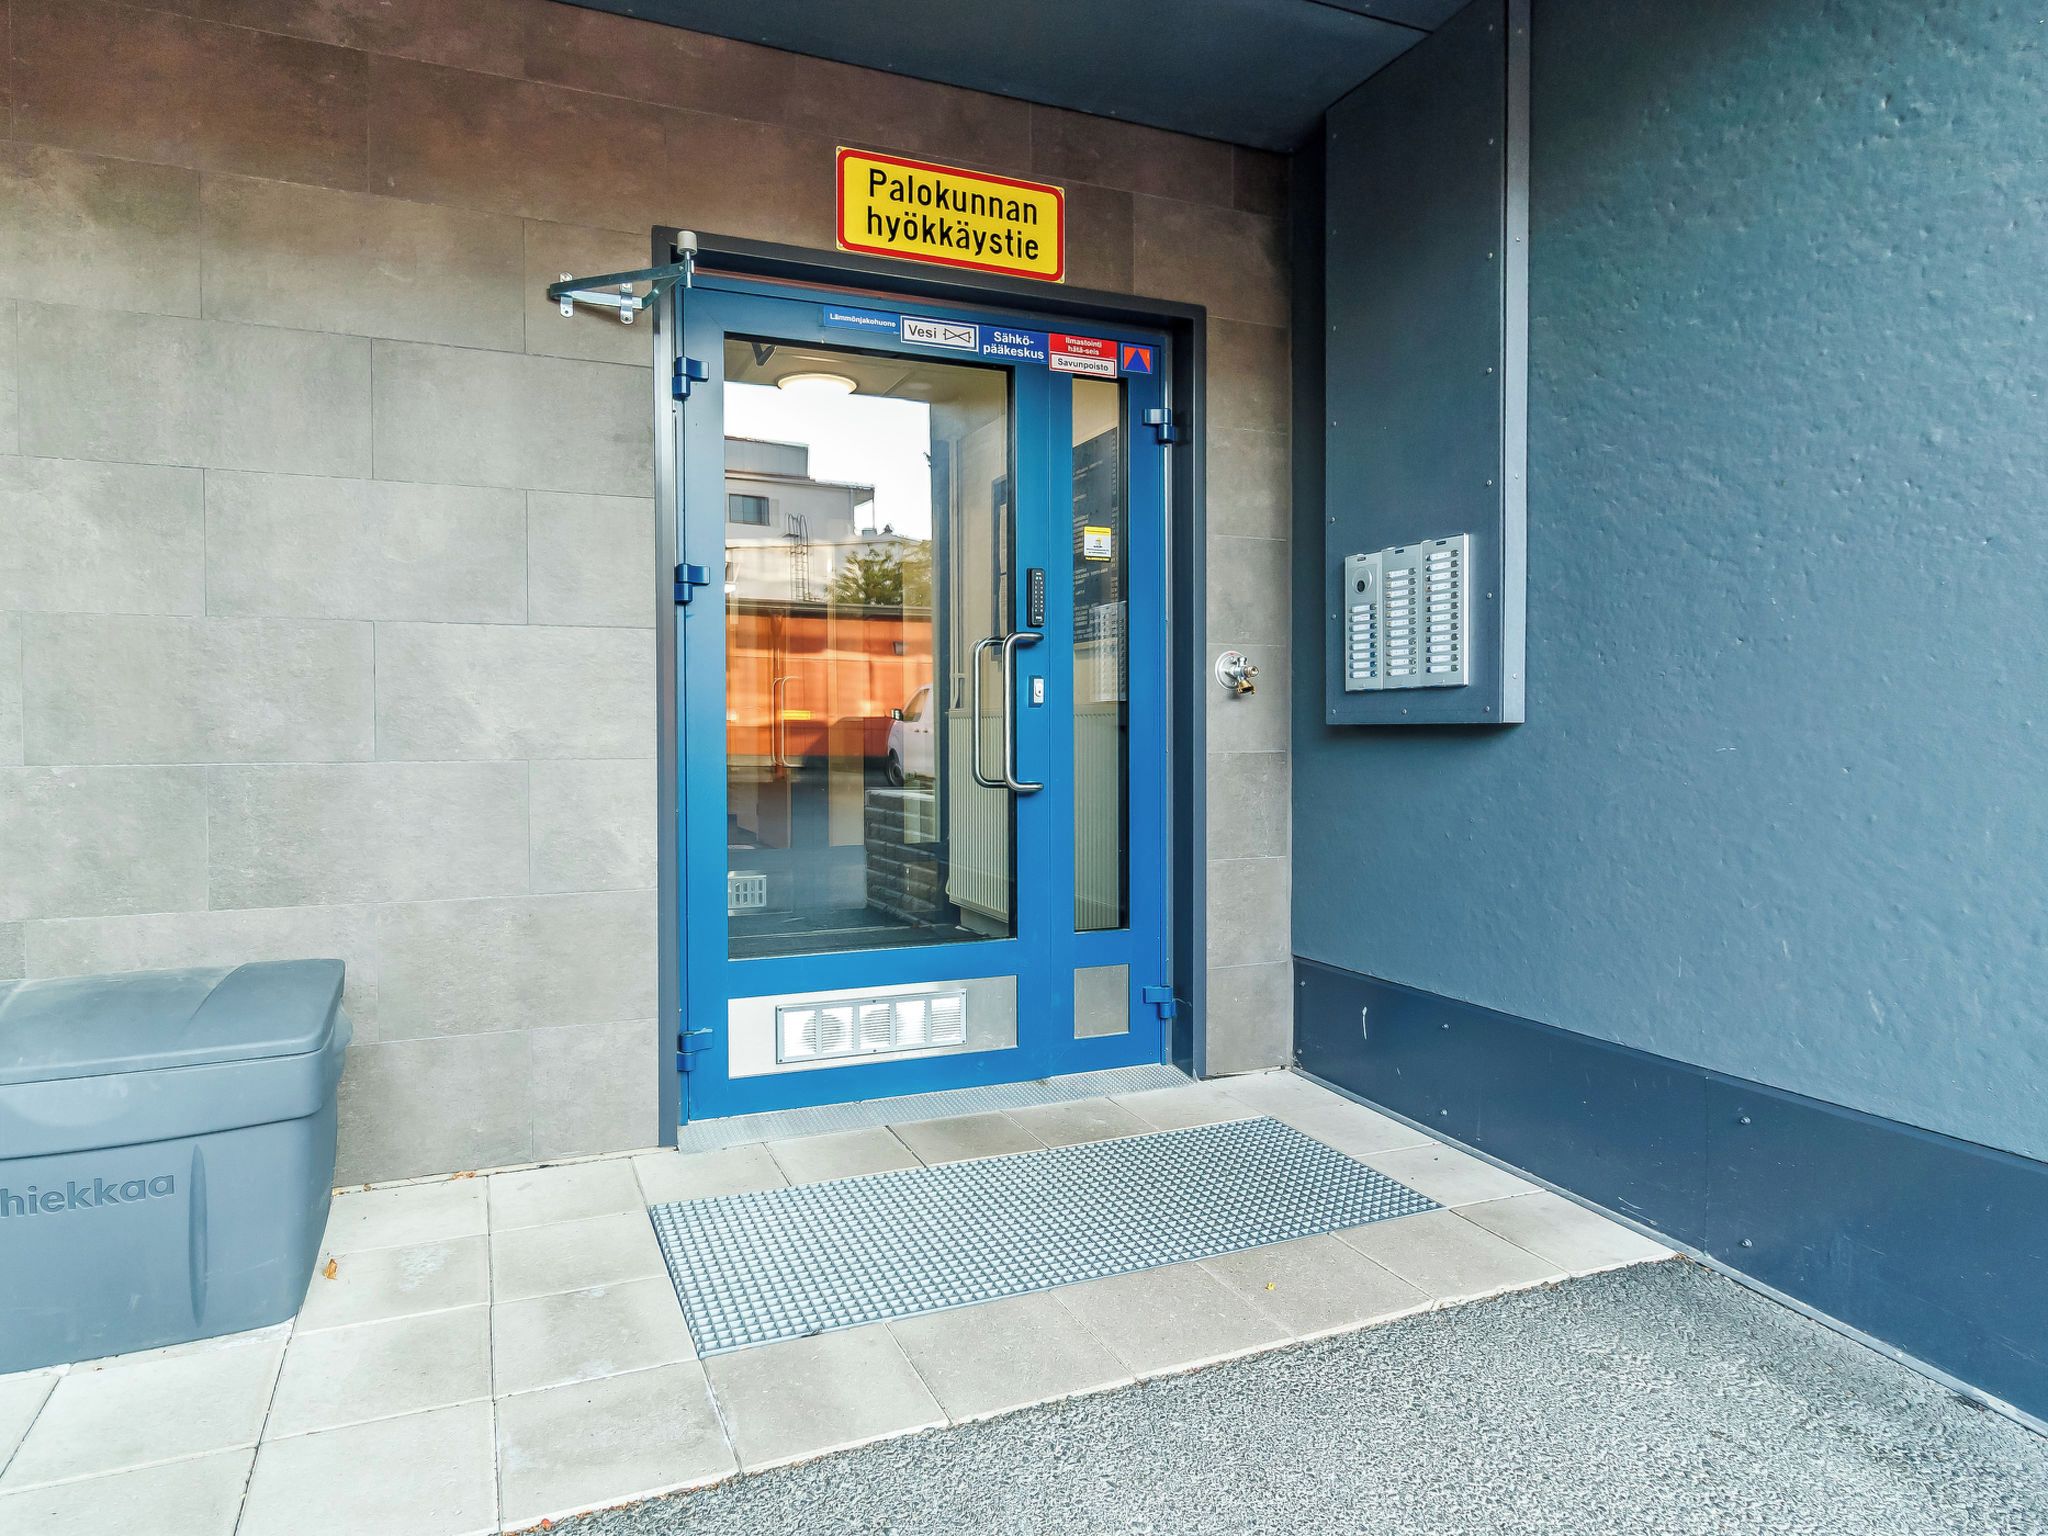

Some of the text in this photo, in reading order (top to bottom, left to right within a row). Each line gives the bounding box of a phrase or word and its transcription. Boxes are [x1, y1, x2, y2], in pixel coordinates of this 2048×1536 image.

[869, 168, 1037, 225] Palokunnan
[867, 206, 1039, 260] hyökkäystie
[908, 324, 937, 339] Vesi
[993, 332, 1034, 346] Sähkö-
[983, 343, 1045, 360] pääkeskus
[1057, 358, 1109, 372] Savunpoisto
[0, 1175, 175, 1218] hiekkaa
